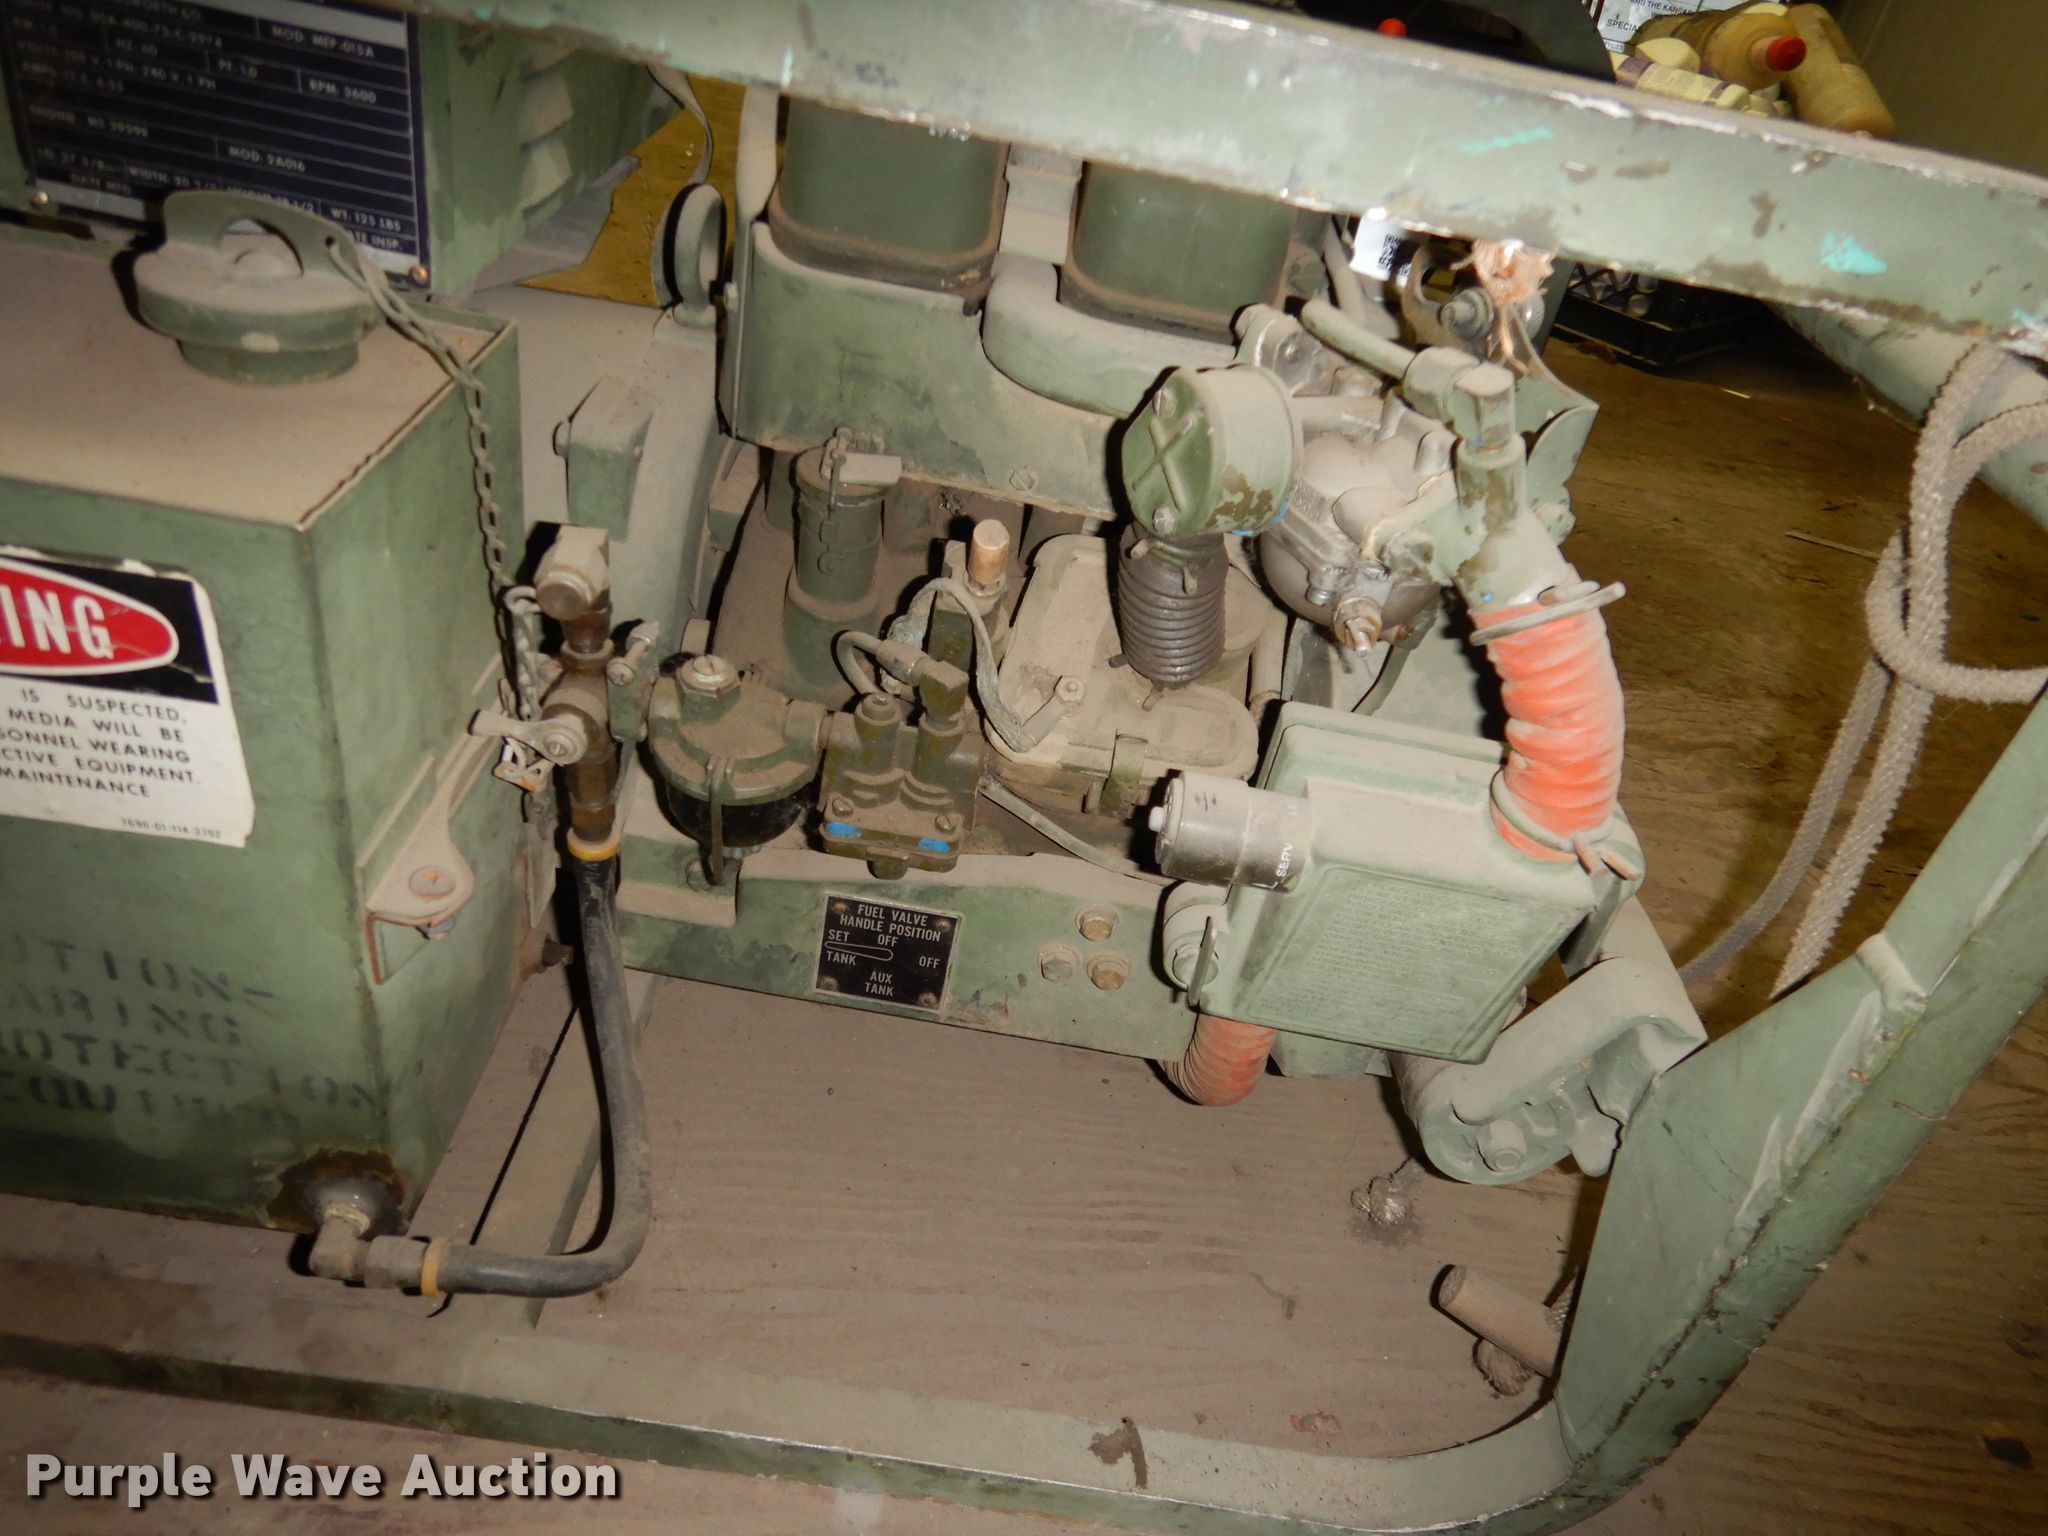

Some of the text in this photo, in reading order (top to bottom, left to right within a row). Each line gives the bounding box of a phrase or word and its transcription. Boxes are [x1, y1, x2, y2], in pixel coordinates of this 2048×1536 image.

[1648, 1, 1662, 10] THE
[1606, 18, 1638, 33] SPECIA
[22, 687, 39, 703] IS
[9, 708, 184, 744] MEDIA WILL BE
[89, 739, 190, 763] WEARING
[0, 767, 151, 798] MAINTENANCE
[857, 904, 928, 927] FUEL VALVE
[840, 914, 941, 942] HANDLE POSITION
[828, 929, 899, 947] SET OFF
[826, 950, 941, 969] TANK OFF
[869, 971, 893, 984] AUX
[864, 981, 894, 997] TANK
[0, 1028, 377, 1112] OTECTION
